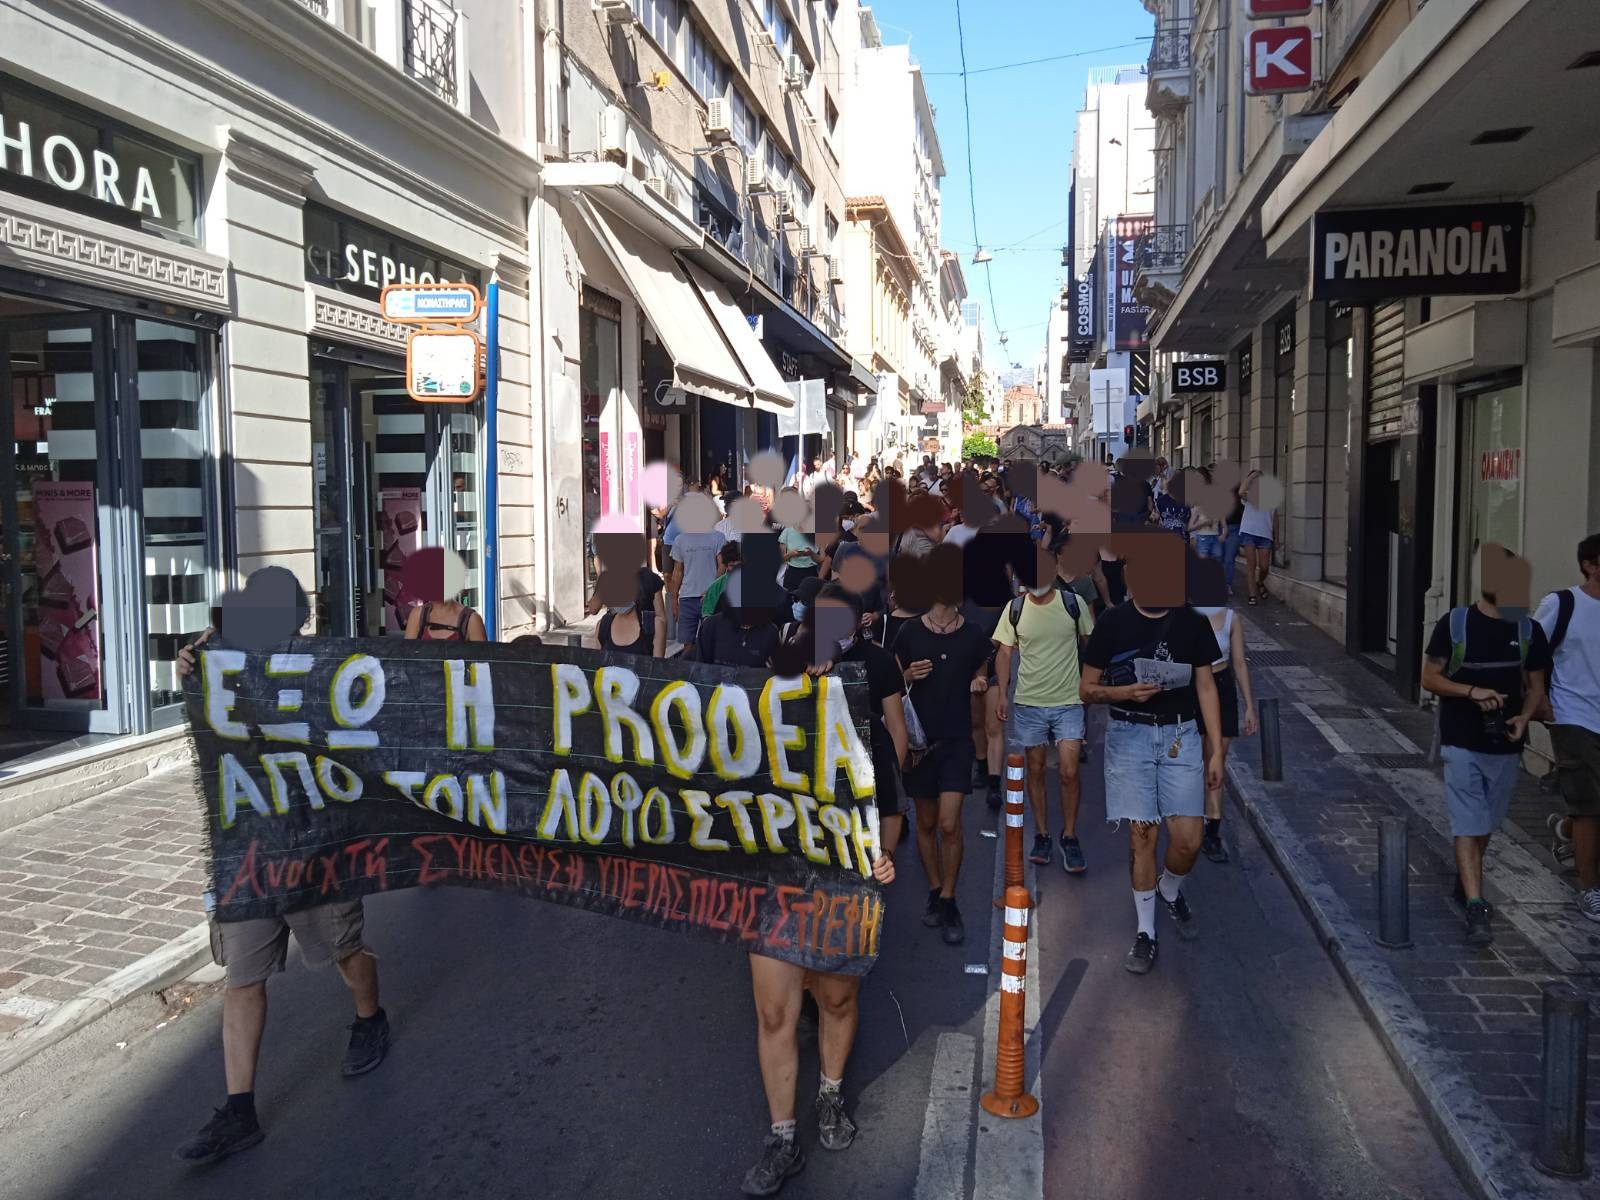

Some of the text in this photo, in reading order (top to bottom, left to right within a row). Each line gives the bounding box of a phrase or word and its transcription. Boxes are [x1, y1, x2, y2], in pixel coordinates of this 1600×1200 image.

[1255, 38, 1306, 78] K
[1177, 366, 1218, 387] BSB
[66, 489, 92, 497] MORE
[444, 659, 495, 752] Η
[218, 752, 363, 829] ΑΠΟ
